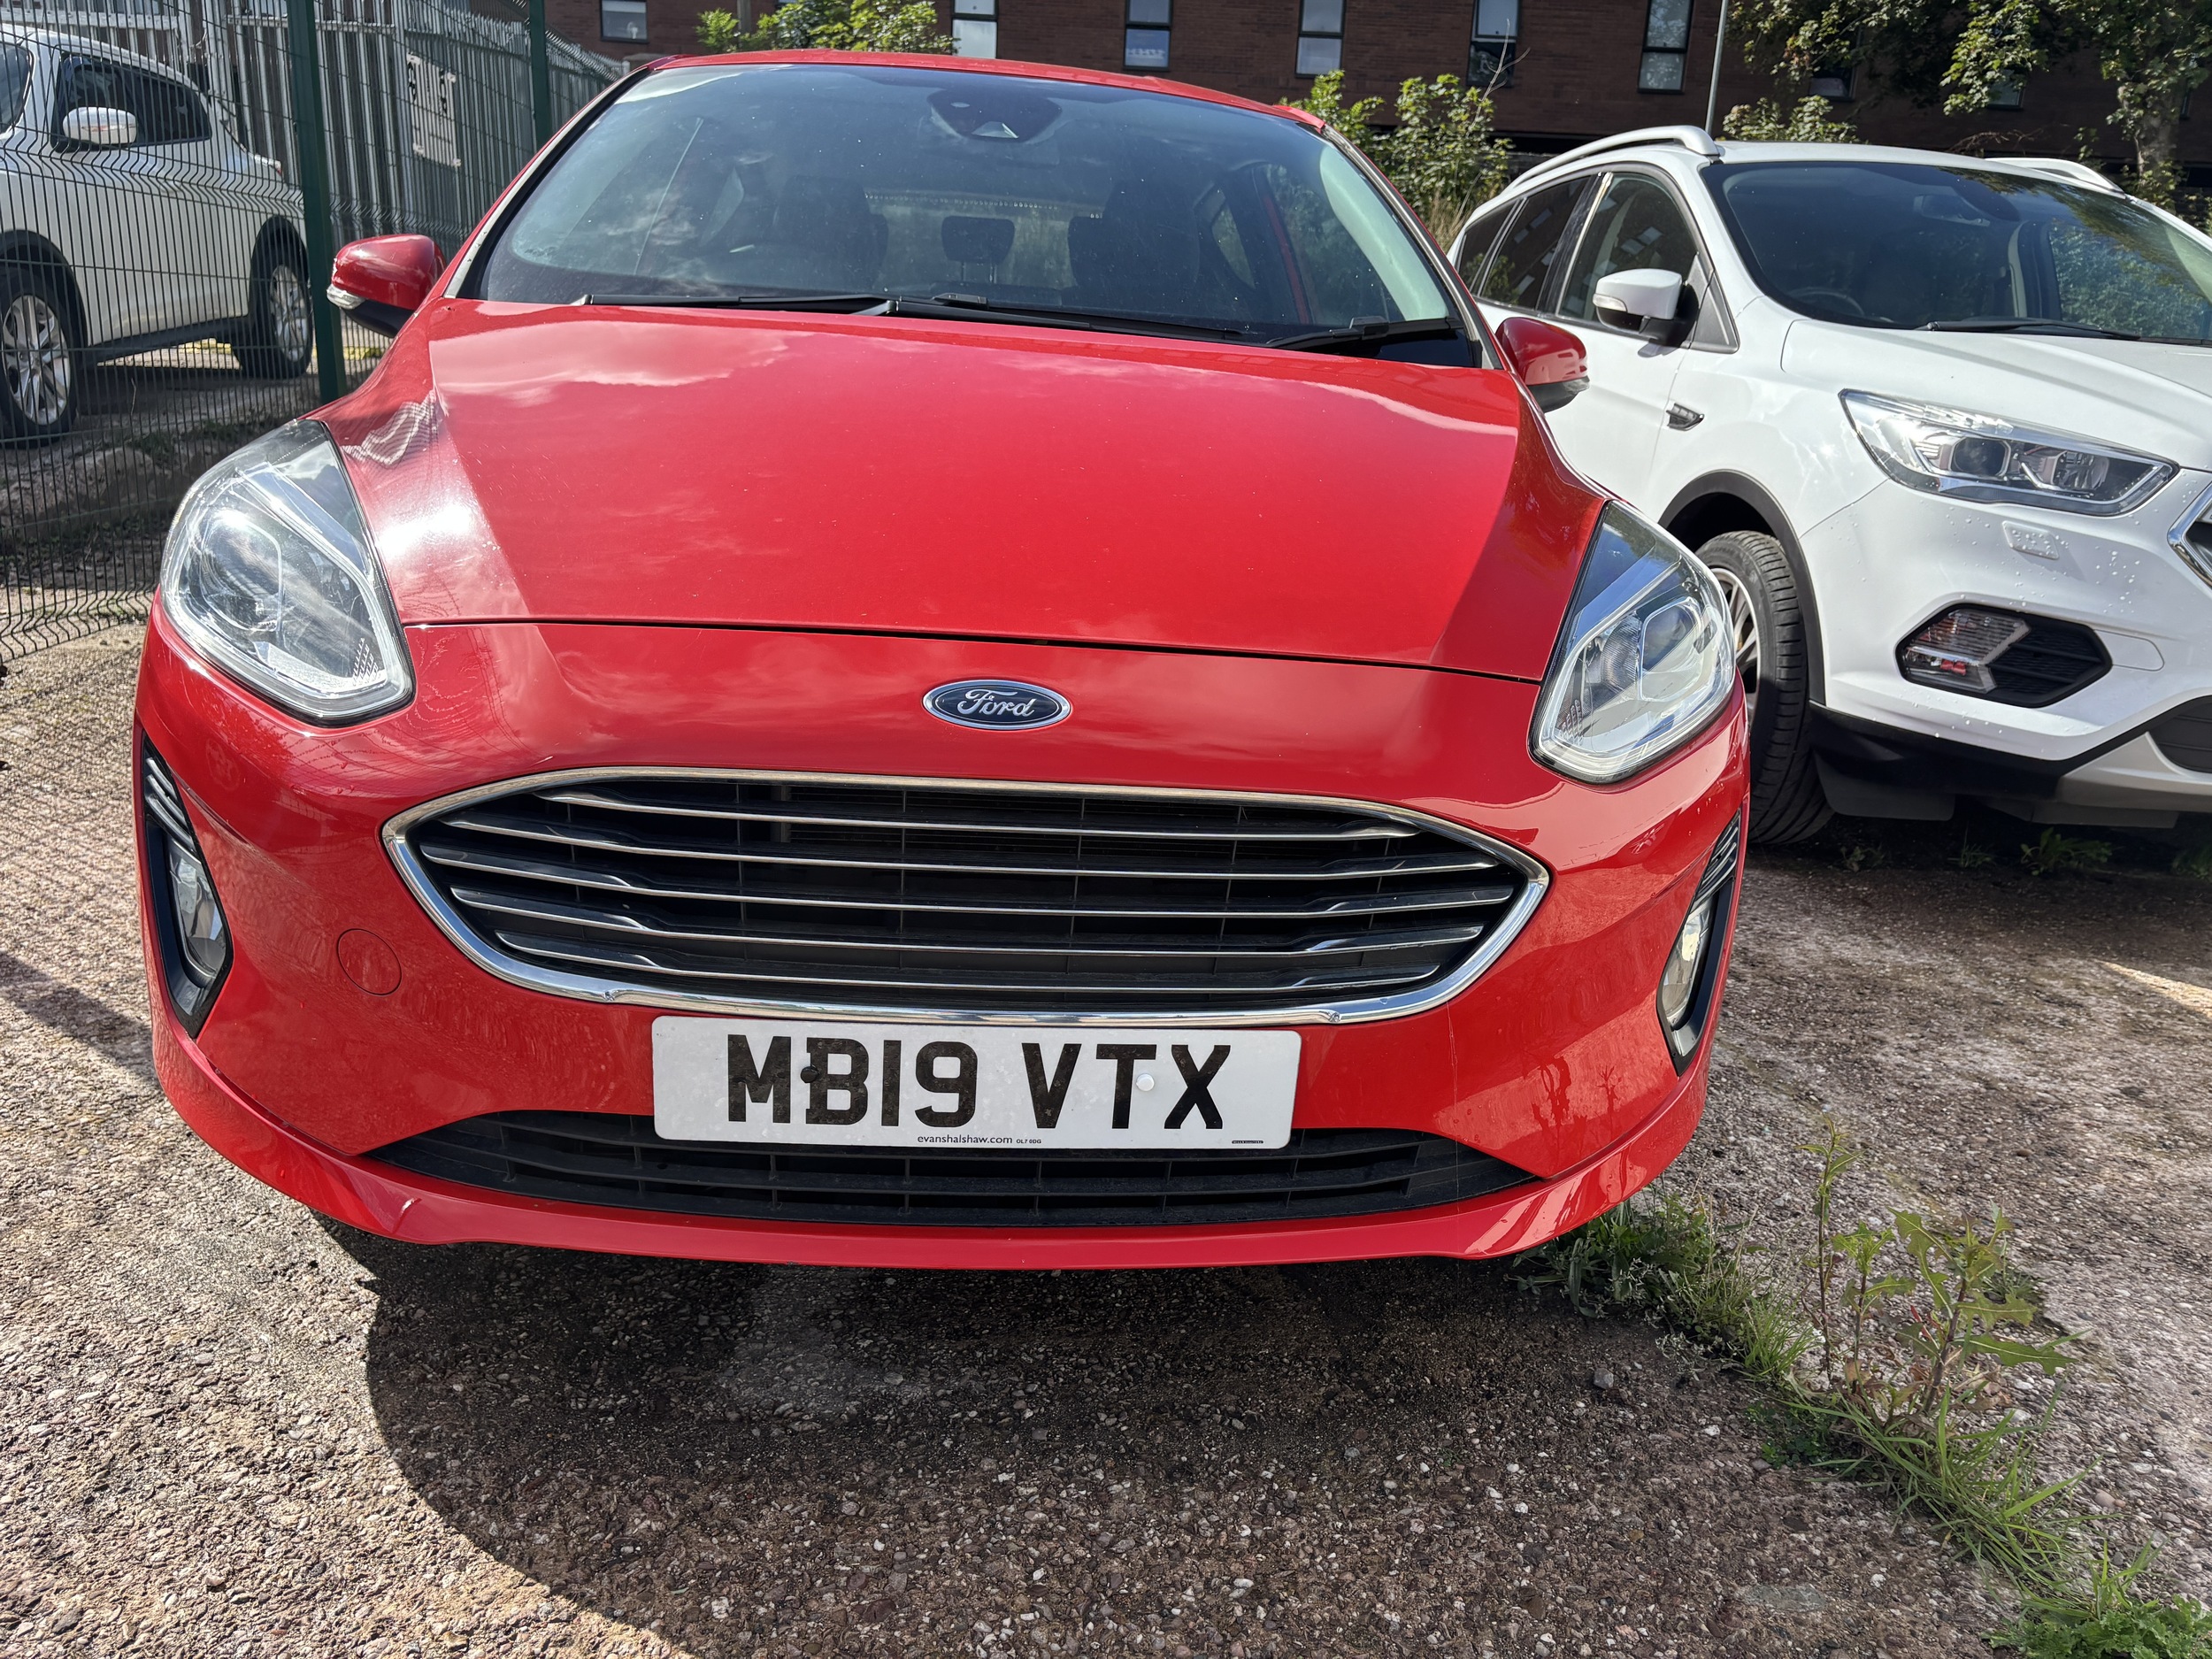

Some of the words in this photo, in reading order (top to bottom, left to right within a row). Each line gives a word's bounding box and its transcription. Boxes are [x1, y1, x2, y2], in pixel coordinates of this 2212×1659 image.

[956, 688, 1036, 718] Ford
[727, 1033, 978, 1127] MB19
[1021, 1042, 1232, 1130] VTX
[917, 1134, 1013, 1144] evanshalshaw.com
